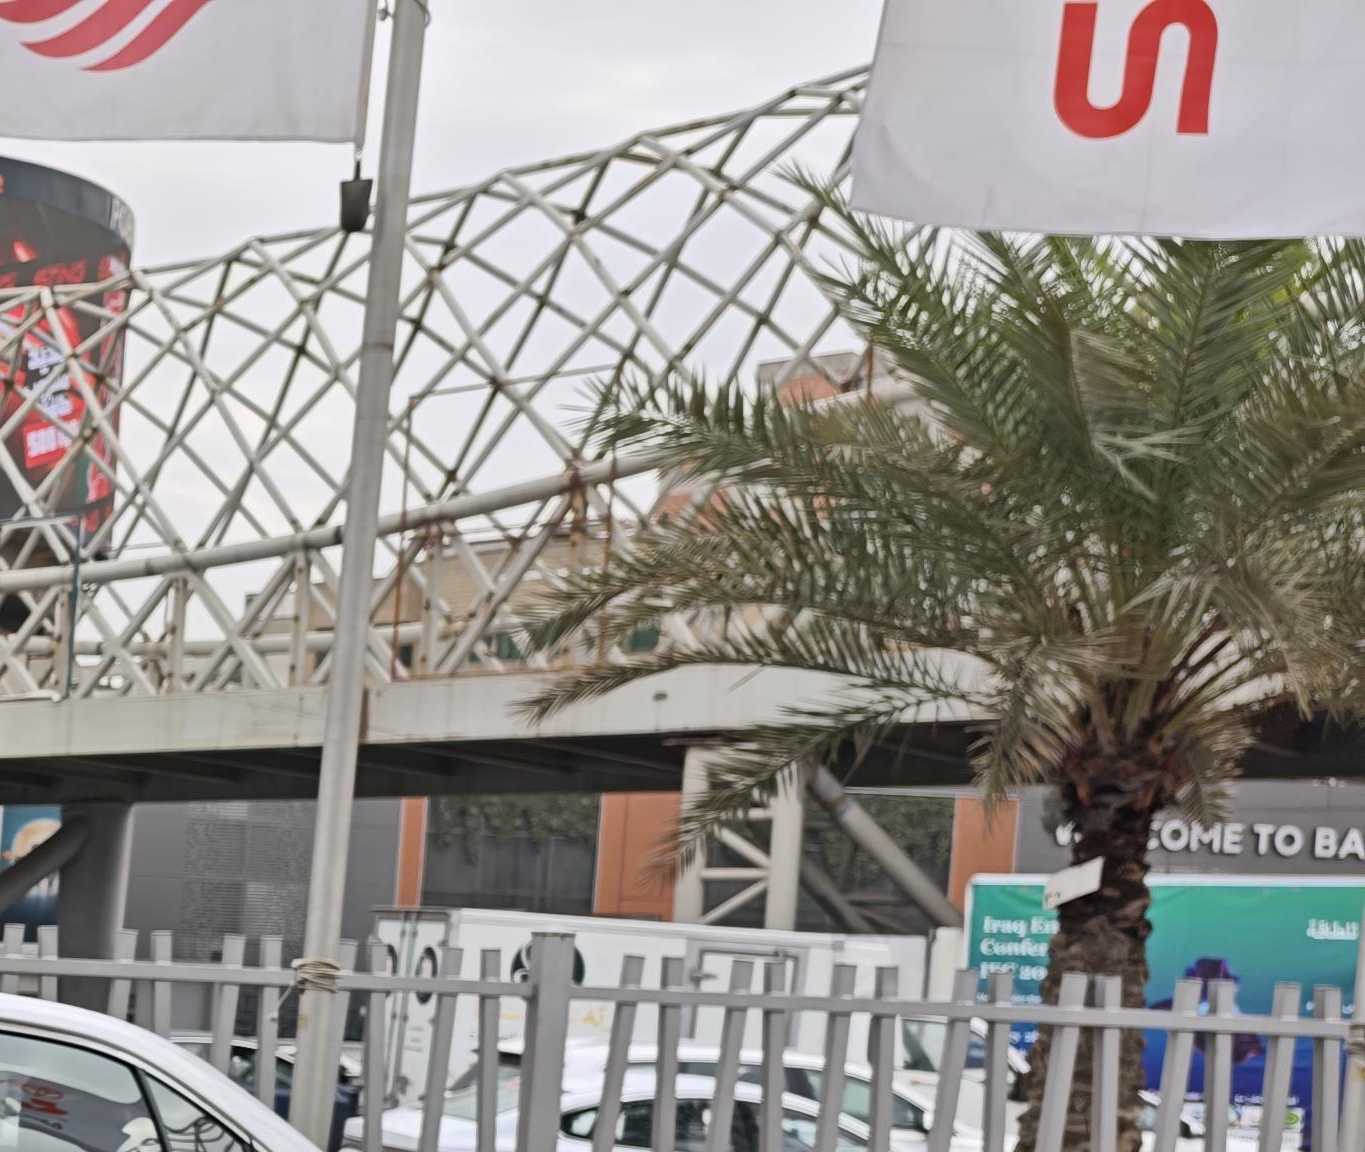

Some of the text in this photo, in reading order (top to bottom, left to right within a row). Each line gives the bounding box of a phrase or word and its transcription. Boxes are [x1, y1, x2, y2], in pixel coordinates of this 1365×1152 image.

[1252, 823, 1304, 857] TO
[1313, 826, 1365, 859] BA
[983, 915, 1028, 937] Iraq
